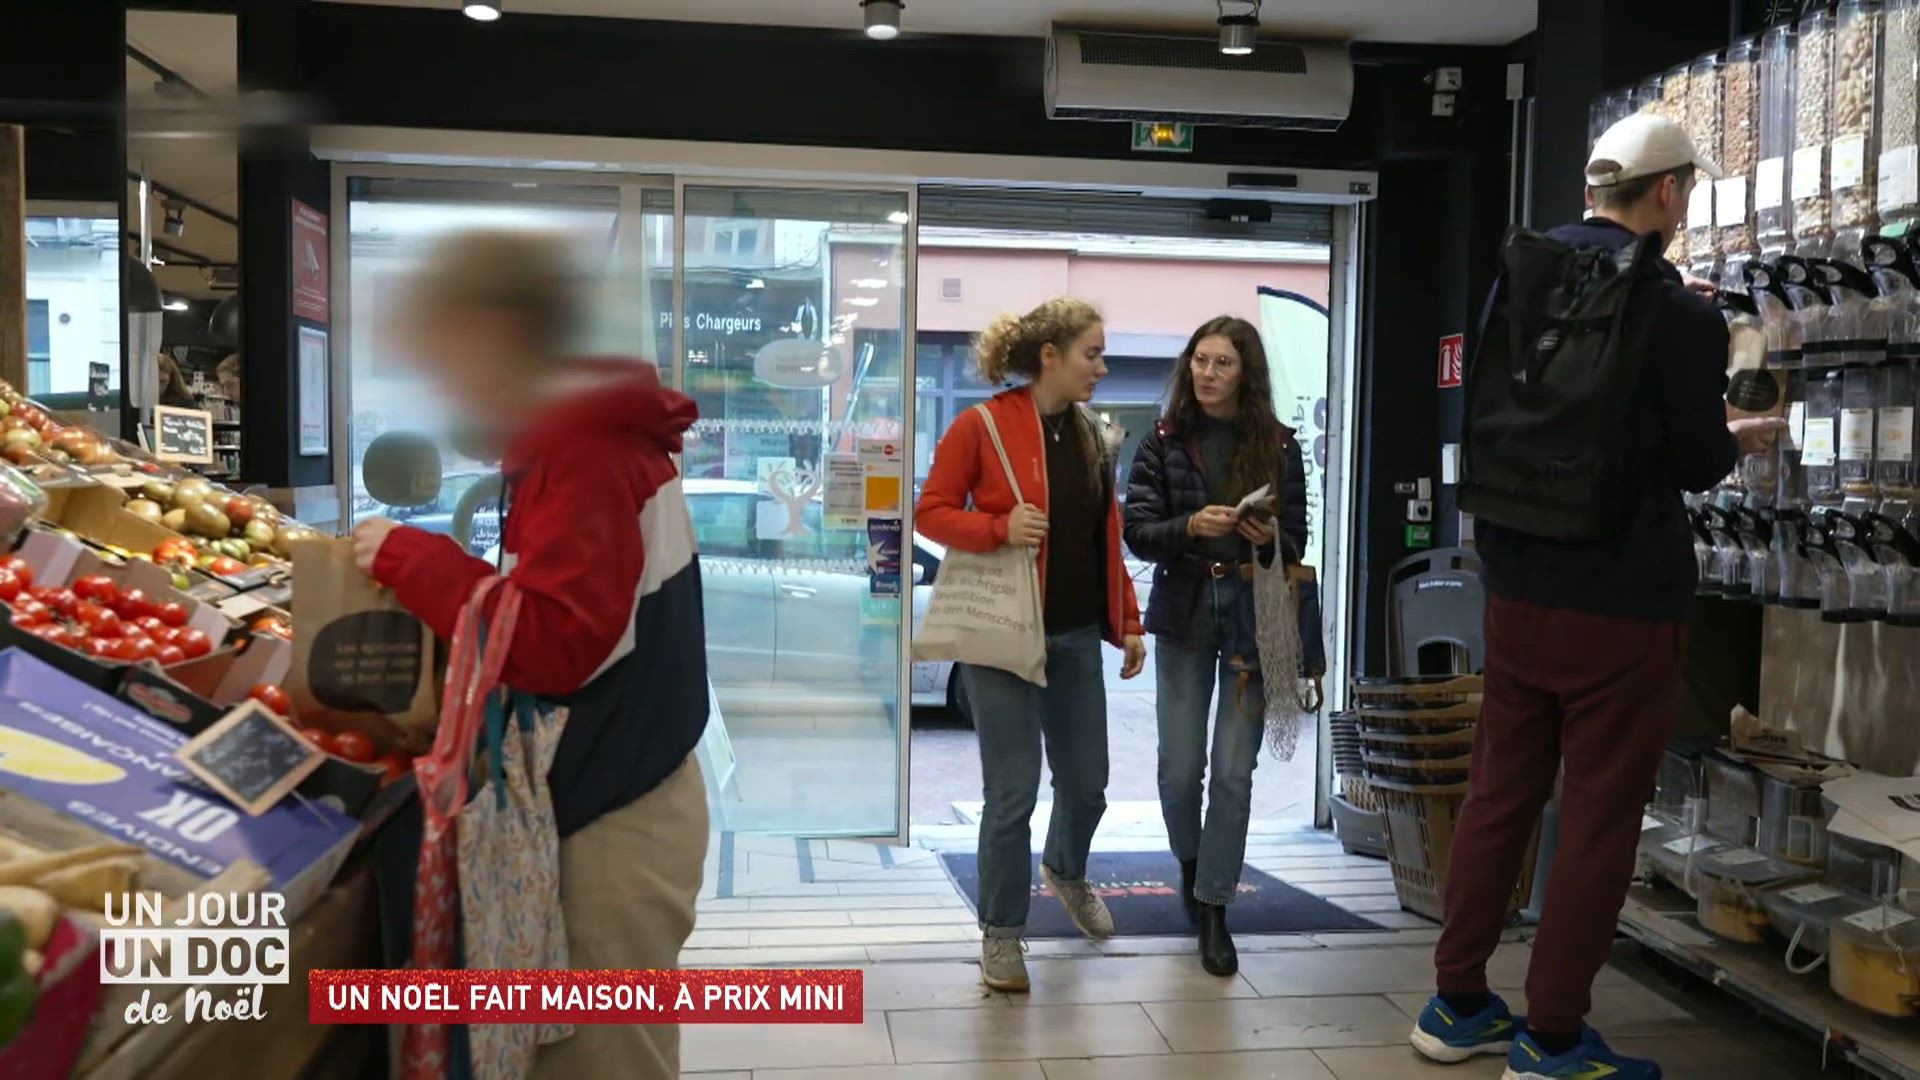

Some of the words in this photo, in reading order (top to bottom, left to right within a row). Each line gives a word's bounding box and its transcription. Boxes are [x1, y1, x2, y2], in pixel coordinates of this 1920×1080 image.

[660, 312, 690, 329] Pis
[696, 313, 762, 335] Chargeurs
[66, 800, 223, 875] ENDIVES
[134, 790, 239, 843] OK
